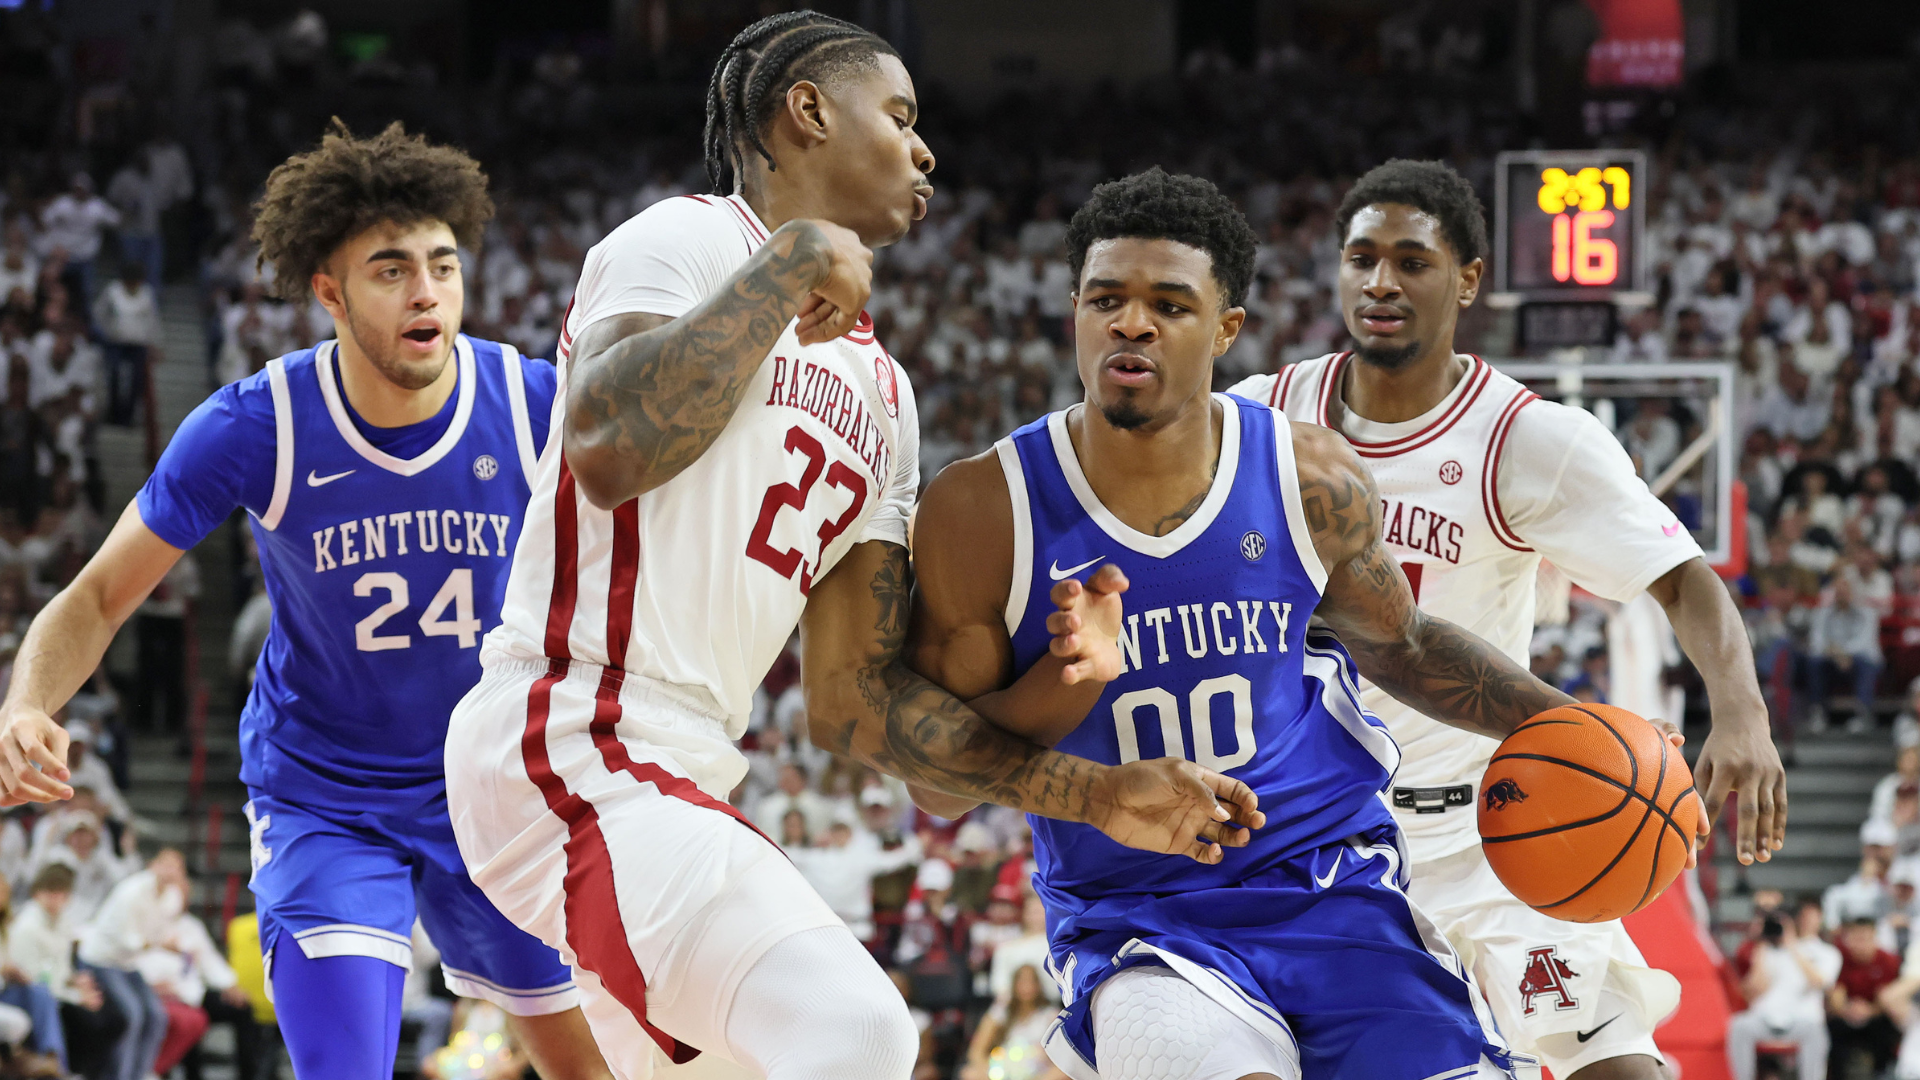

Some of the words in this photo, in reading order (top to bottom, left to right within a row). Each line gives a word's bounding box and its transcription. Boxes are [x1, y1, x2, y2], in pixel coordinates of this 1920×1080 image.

[1538, 166, 1630, 214] 2:57
[1552, 210, 1617, 285] 16
[766, 357, 891, 500] RAZORBACKS
[474, 456, 497, 479] SEC
[1441, 462, 1461, 484] SEC
[313, 510, 510, 573] KENTUCKY
[746, 425, 867, 598] 23
[1241, 531, 1265, 560] SEC
[353, 568, 481, 651] 24
[1117, 601, 1292, 675] NTUCKY
[1112, 673, 1257, 773] 00
[1448, 791, 1462, 801] 44
